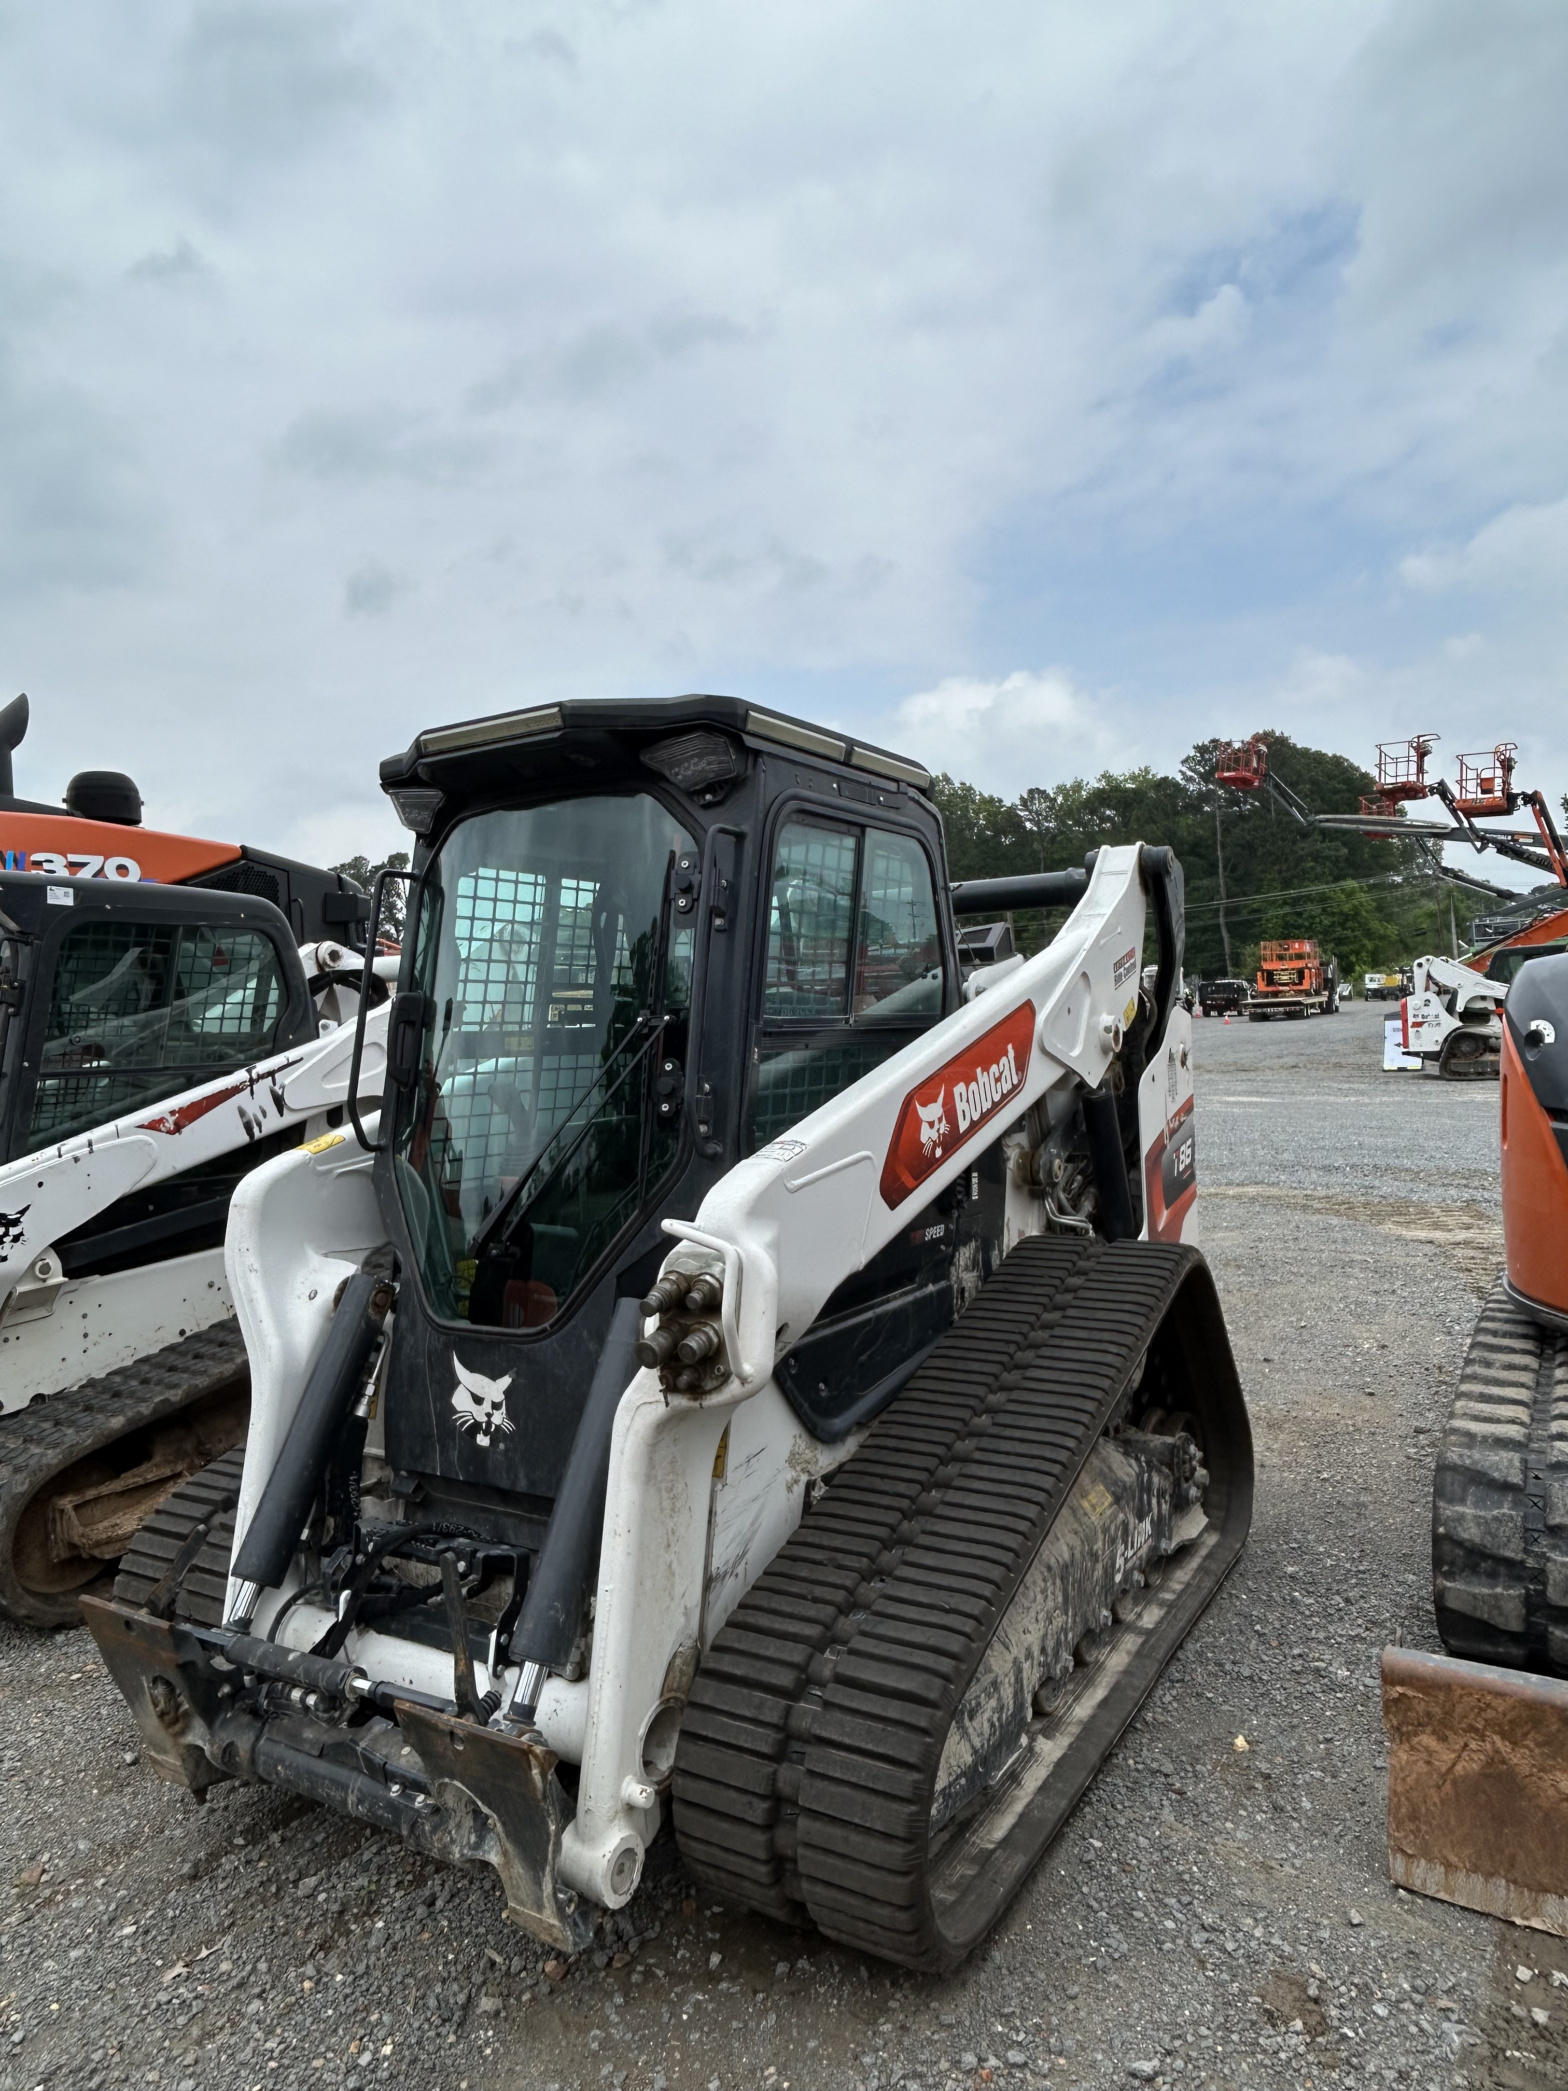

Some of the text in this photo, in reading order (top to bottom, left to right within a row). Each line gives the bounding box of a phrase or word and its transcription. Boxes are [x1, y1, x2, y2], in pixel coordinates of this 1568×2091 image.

[30, 852, 141, 882] 370
[953, 1043, 1018, 1134] Bobcat
[925, 1224, 945, 1241] SPEED
